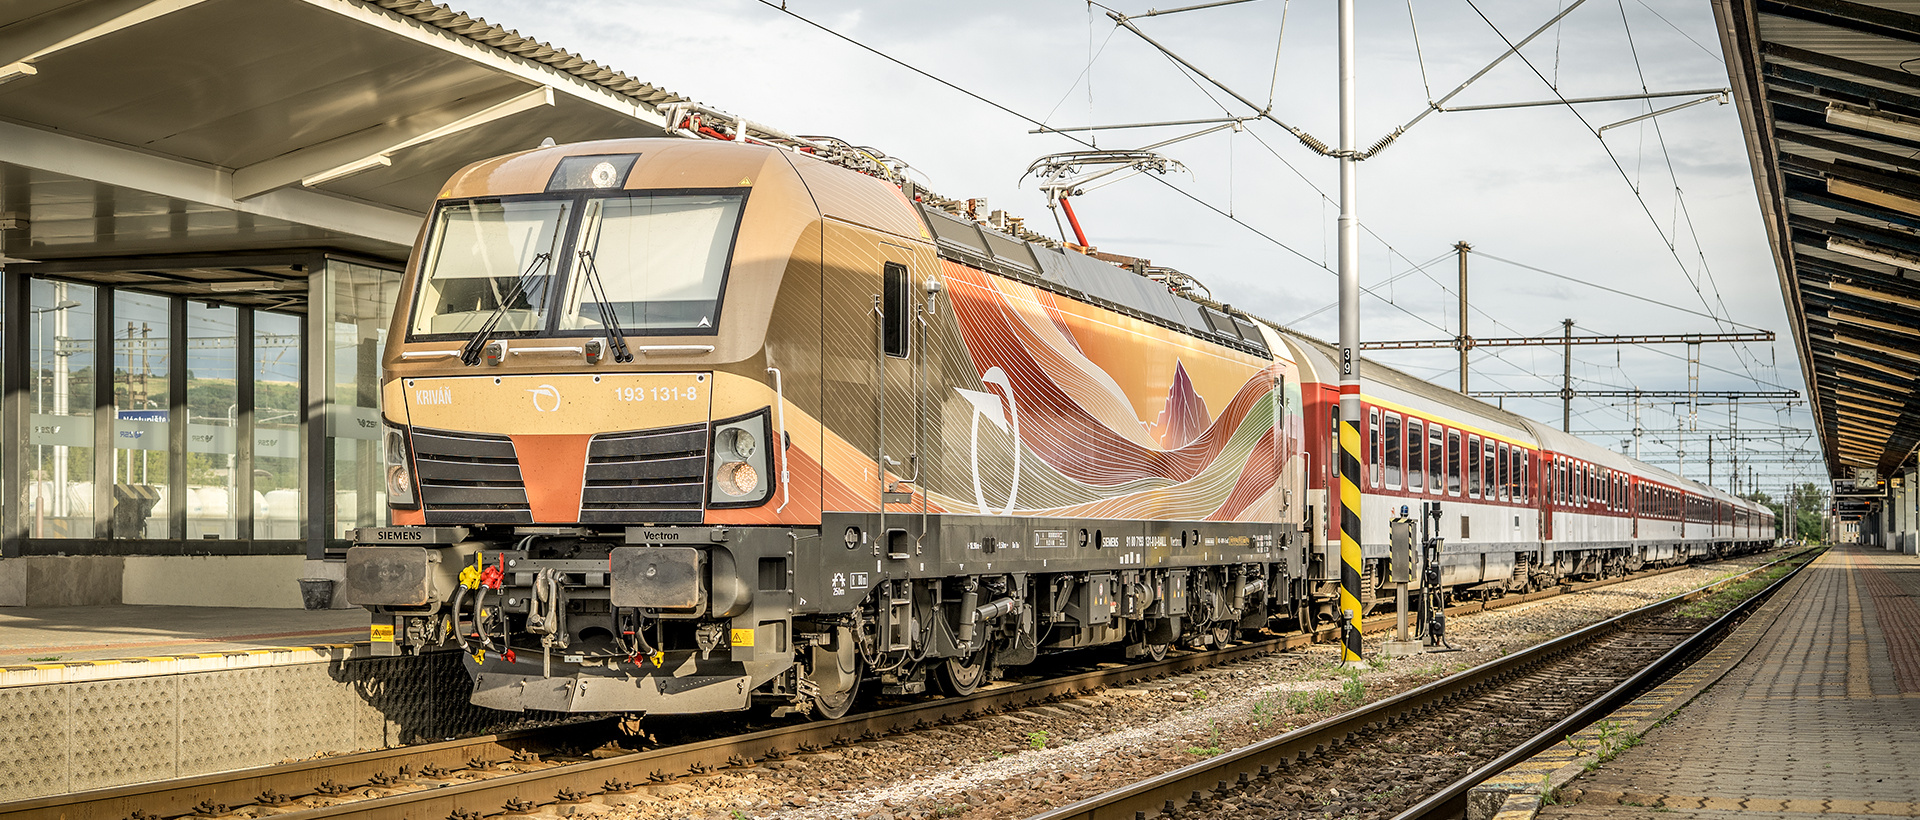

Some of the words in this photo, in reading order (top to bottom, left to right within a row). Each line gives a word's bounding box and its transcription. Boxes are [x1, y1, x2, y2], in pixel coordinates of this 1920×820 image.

[415, 386, 452, 405] KRIVÁŇ
[615, 387, 645, 402] 193
[651, 386, 698, 402] 131-8
[377, 530, 422, 541] SIEMENS
[643, 530, 679, 541] Vectron
